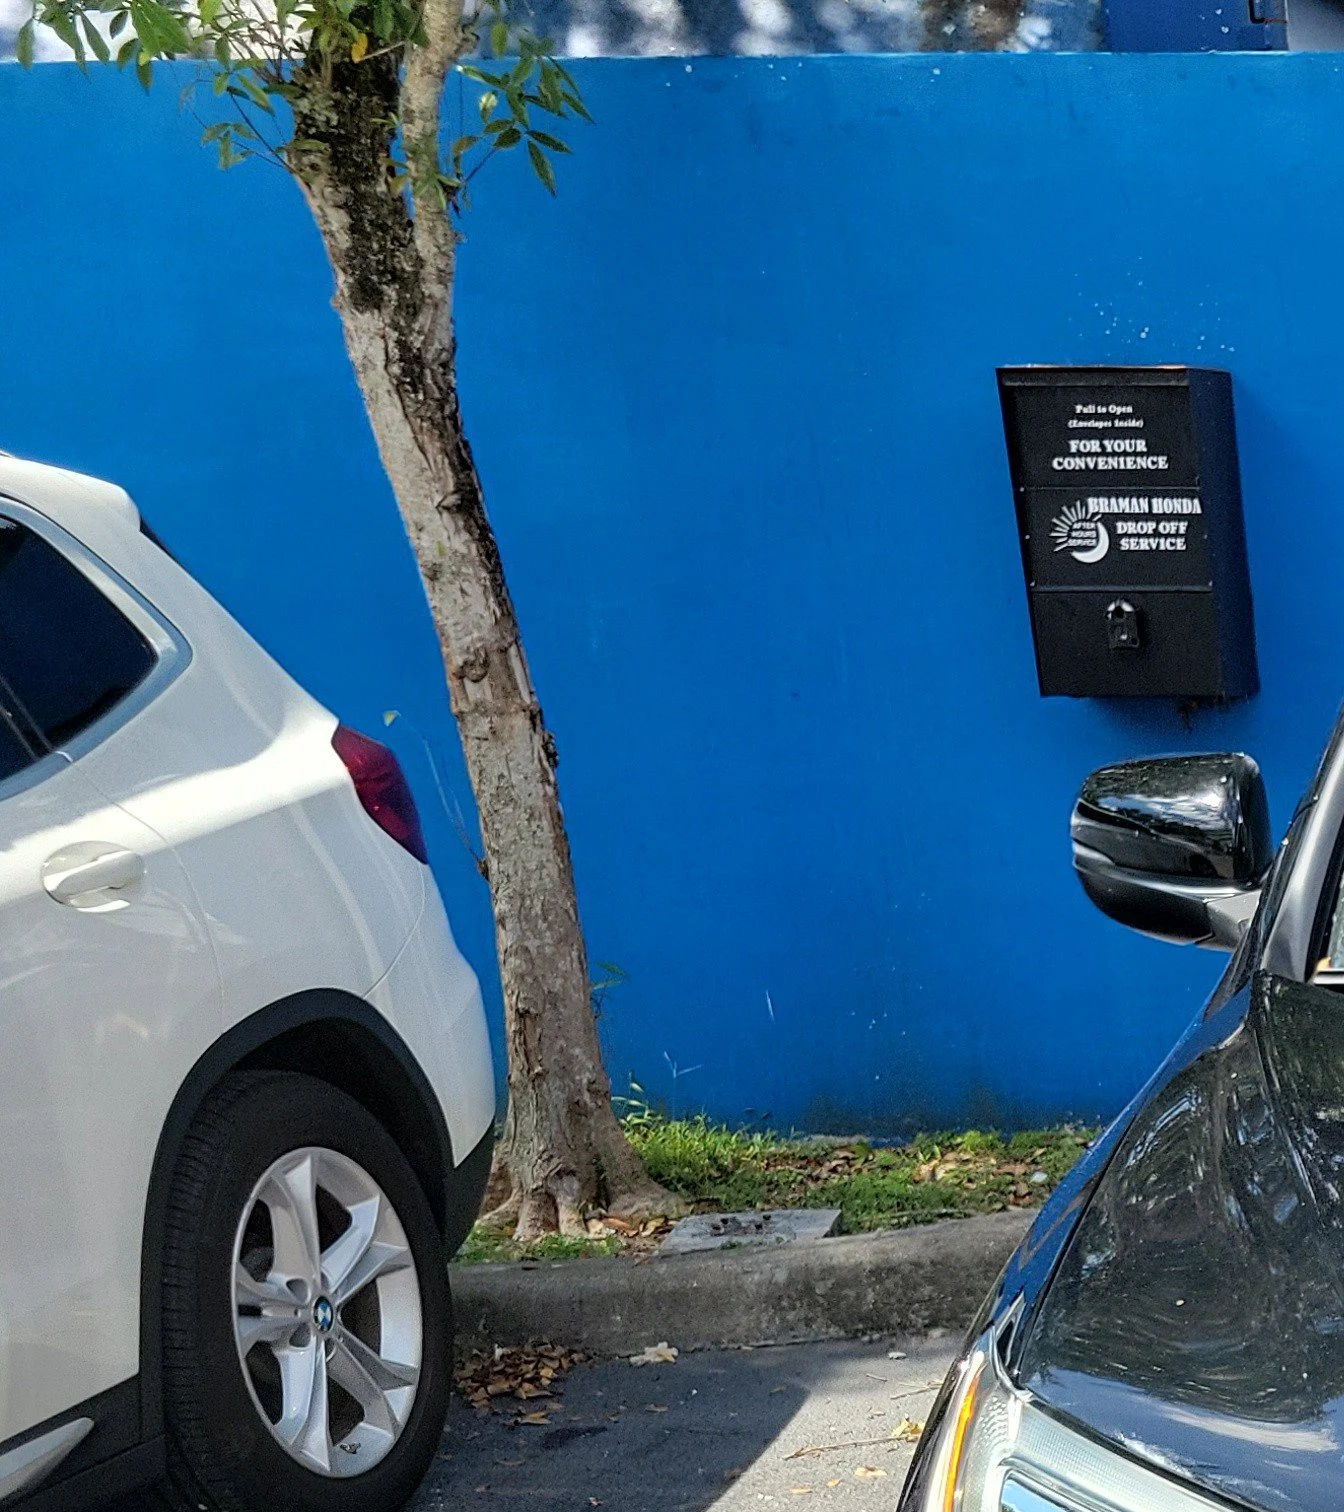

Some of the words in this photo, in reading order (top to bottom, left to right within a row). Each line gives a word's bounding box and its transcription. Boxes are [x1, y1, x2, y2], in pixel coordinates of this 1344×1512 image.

[1075, 404, 1096, 414] Pull
[1097, 404, 1107, 414] to
[1108, 404, 1133, 416] Open
[1068, 439, 1102, 453] FOR
[1102, 439, 1147, 453] YOUR
[1052, 456, 1169, 470] CONVENIENCE
[1087, 497, 1149, 514] BRAMAN
[1151, 498, 1202, 514] HONDA
[1115, 521, 1156, 535] DROP
[1158, 521, 1188, 535] OFF
[1119, 538, 1187, 551] SERVICE
